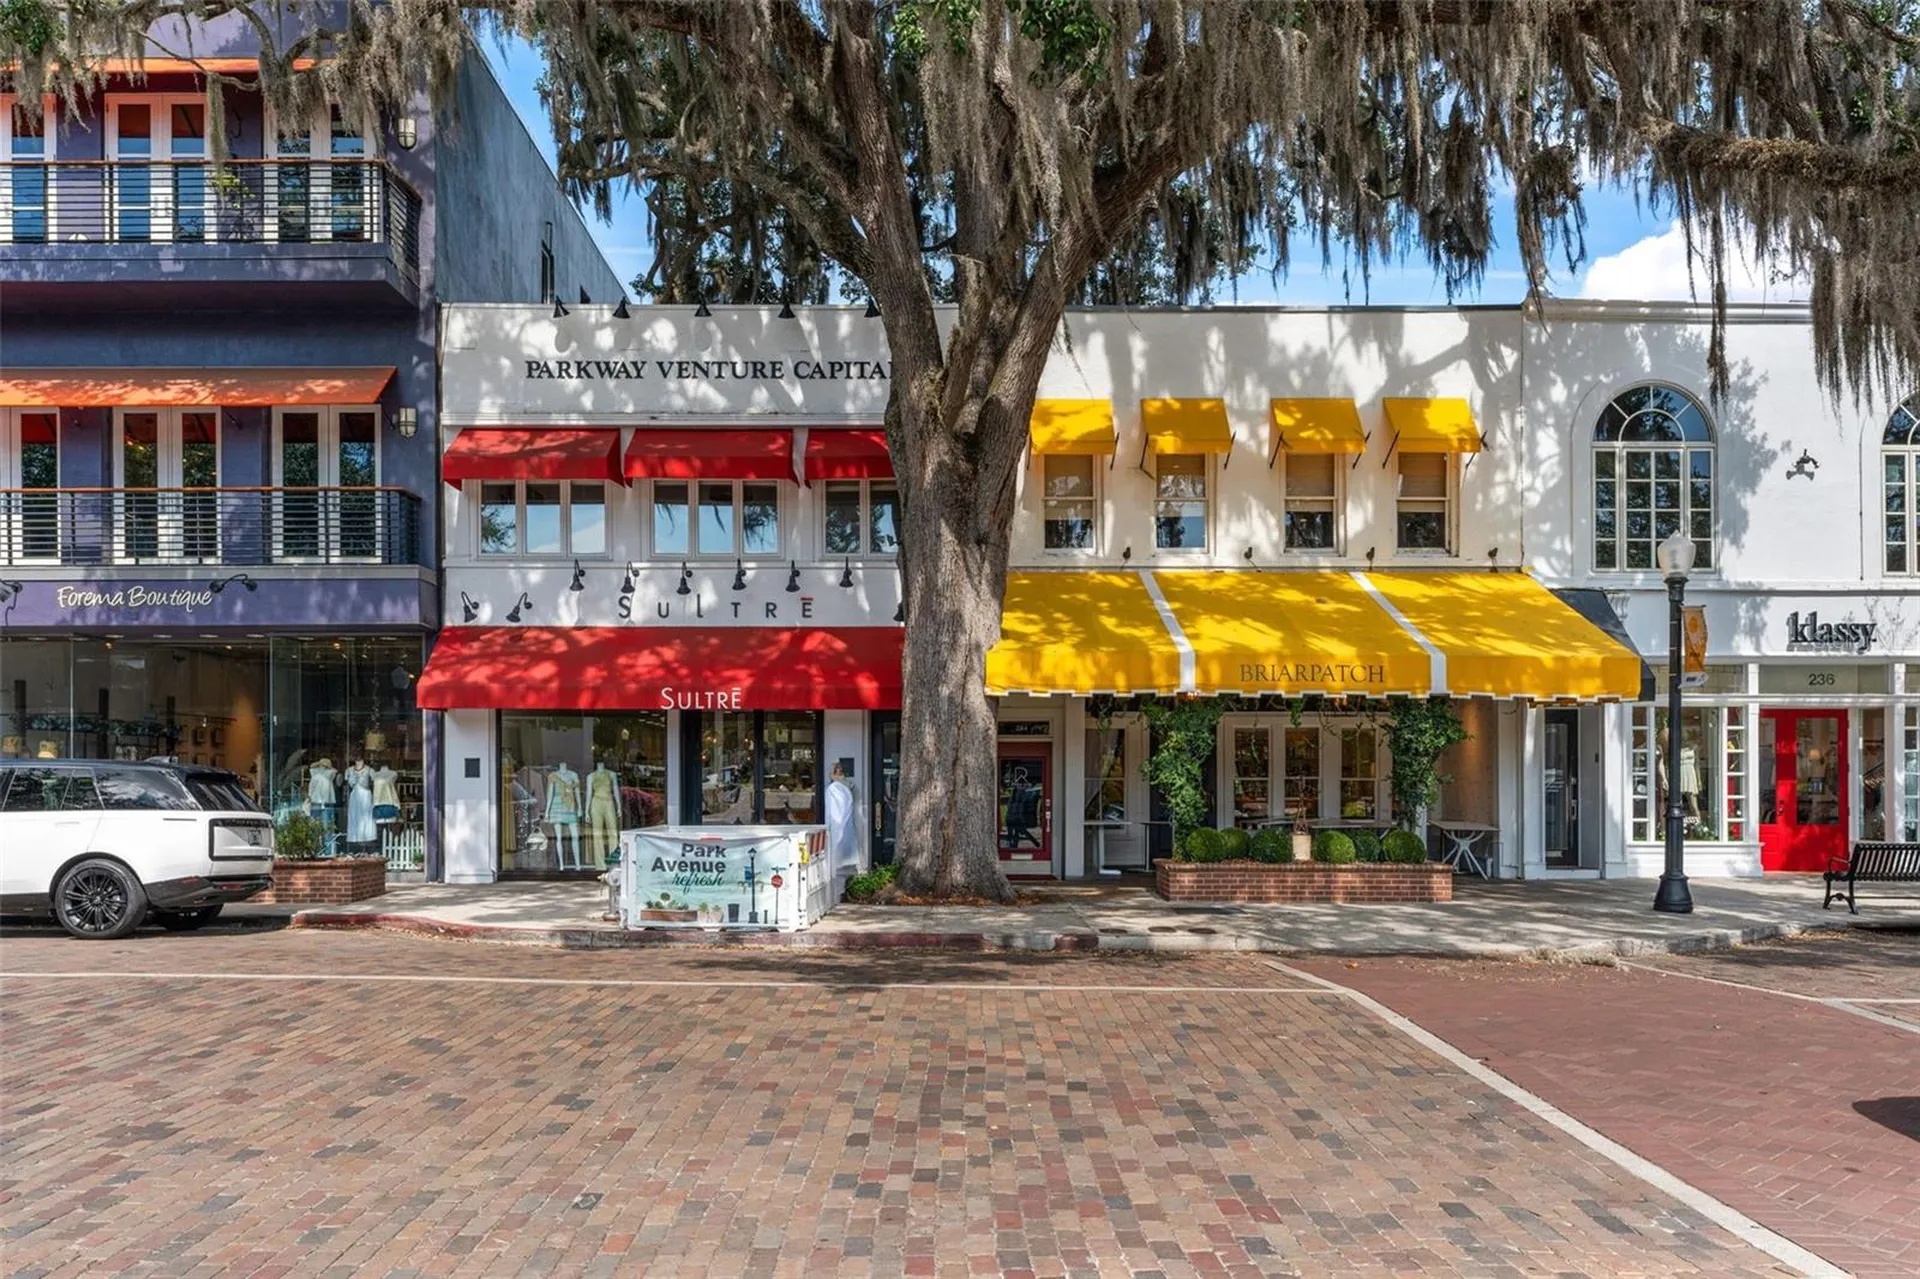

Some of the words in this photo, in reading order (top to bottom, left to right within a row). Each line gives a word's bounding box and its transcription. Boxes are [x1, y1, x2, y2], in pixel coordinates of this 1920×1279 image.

[526, 360, 647, 380] PARKWAY
[656, 360, 785, 380] VENTURE
[793, 360, 892, 380] CAPITA
[57, 585, 125, 608] Forema
[127, 585, 213, 613] Boutique
[1240, 664, 1384, 683] BRIARPATCH
[1808, 673, 1836, 686] 236
[681, 843, 727, 858] Park
[651, 857, 726, 873] Avenue
[671, 870, 725, 895] refresh
